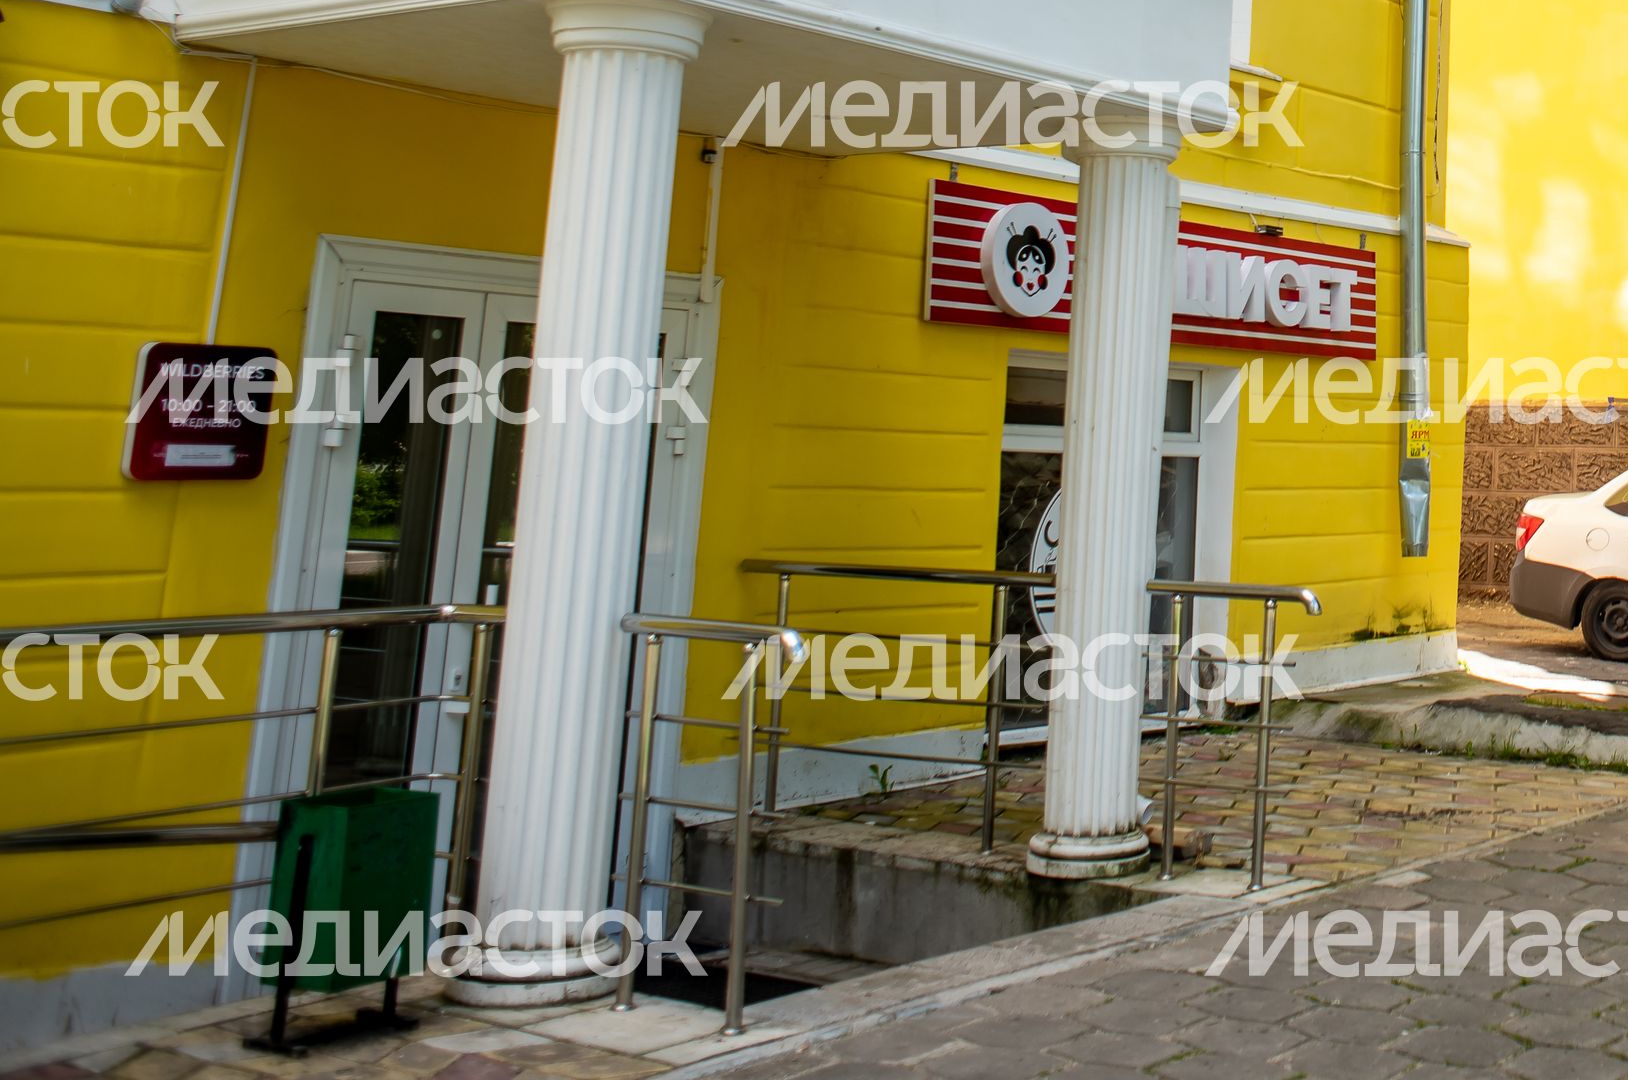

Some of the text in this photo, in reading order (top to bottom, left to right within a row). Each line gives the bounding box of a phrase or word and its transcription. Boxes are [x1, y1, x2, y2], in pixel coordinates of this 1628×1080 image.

[1175, 245, 1358, 332] ШИСЕТ
[161, 363, 265, 380] WILDBERRIES
[162, 398, 203, 412] 10:00
[217, 400, 257, 413] 21:00
[172, 418, 242, 430] ЕЖЕДНЕВНО
